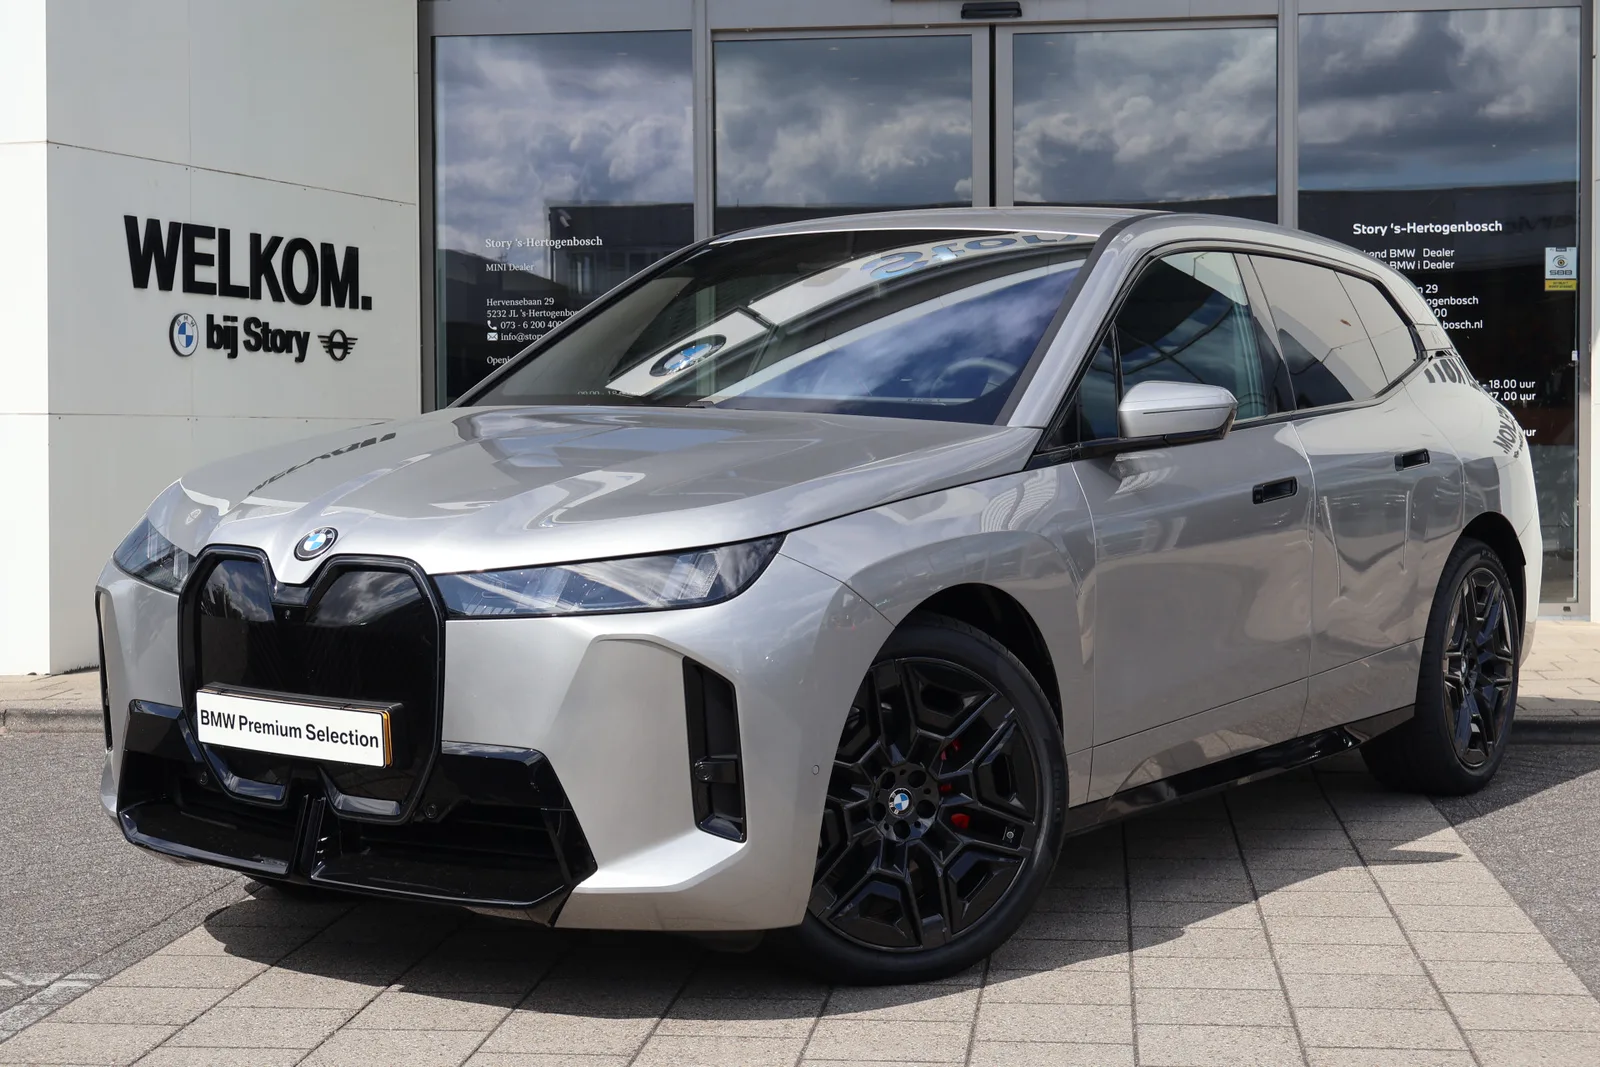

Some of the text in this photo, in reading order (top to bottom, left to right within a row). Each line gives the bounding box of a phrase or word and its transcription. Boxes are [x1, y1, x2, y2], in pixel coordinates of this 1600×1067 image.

[1353, 223, 1388, 236] Story
[1390, 220, 1503, 235] 's-Hertogenbosch
[485, 236, 603, 250] Story 's-Hertogenbosch
[1389, 248, 1416, 258] BMW
[1422, 248, 1455, 258] Dealer
[124, 214, 373, 311] WELKOM.
[485, 263, 535, 272] MINI Dealer
[1389, 261, 1416, 270] BMW
[1417, 261, 1421, 270] i
[1422, 260, 1455, 269] Dealer
[1425, 284, 1439, 294] 29
[486, 297, 555, 306] Hervensebaan 29
[486, 309, 507, 318] 5232
[508, 309, 519, 318] JL
[500, 321, 516, 329] 073
[522, 320, 529, 329] 6
[530, 320, 546, 329] 200
[206, 313, 239, 359] bij
[243, 316, 311, 363] Story
[1489, 379, 1517, 389] 18.00
[1519, 381, 1536, 389] uur
[1519, 393, 1536, 401] uur
[200, 709, 380, 749] BMW Premium Selection
